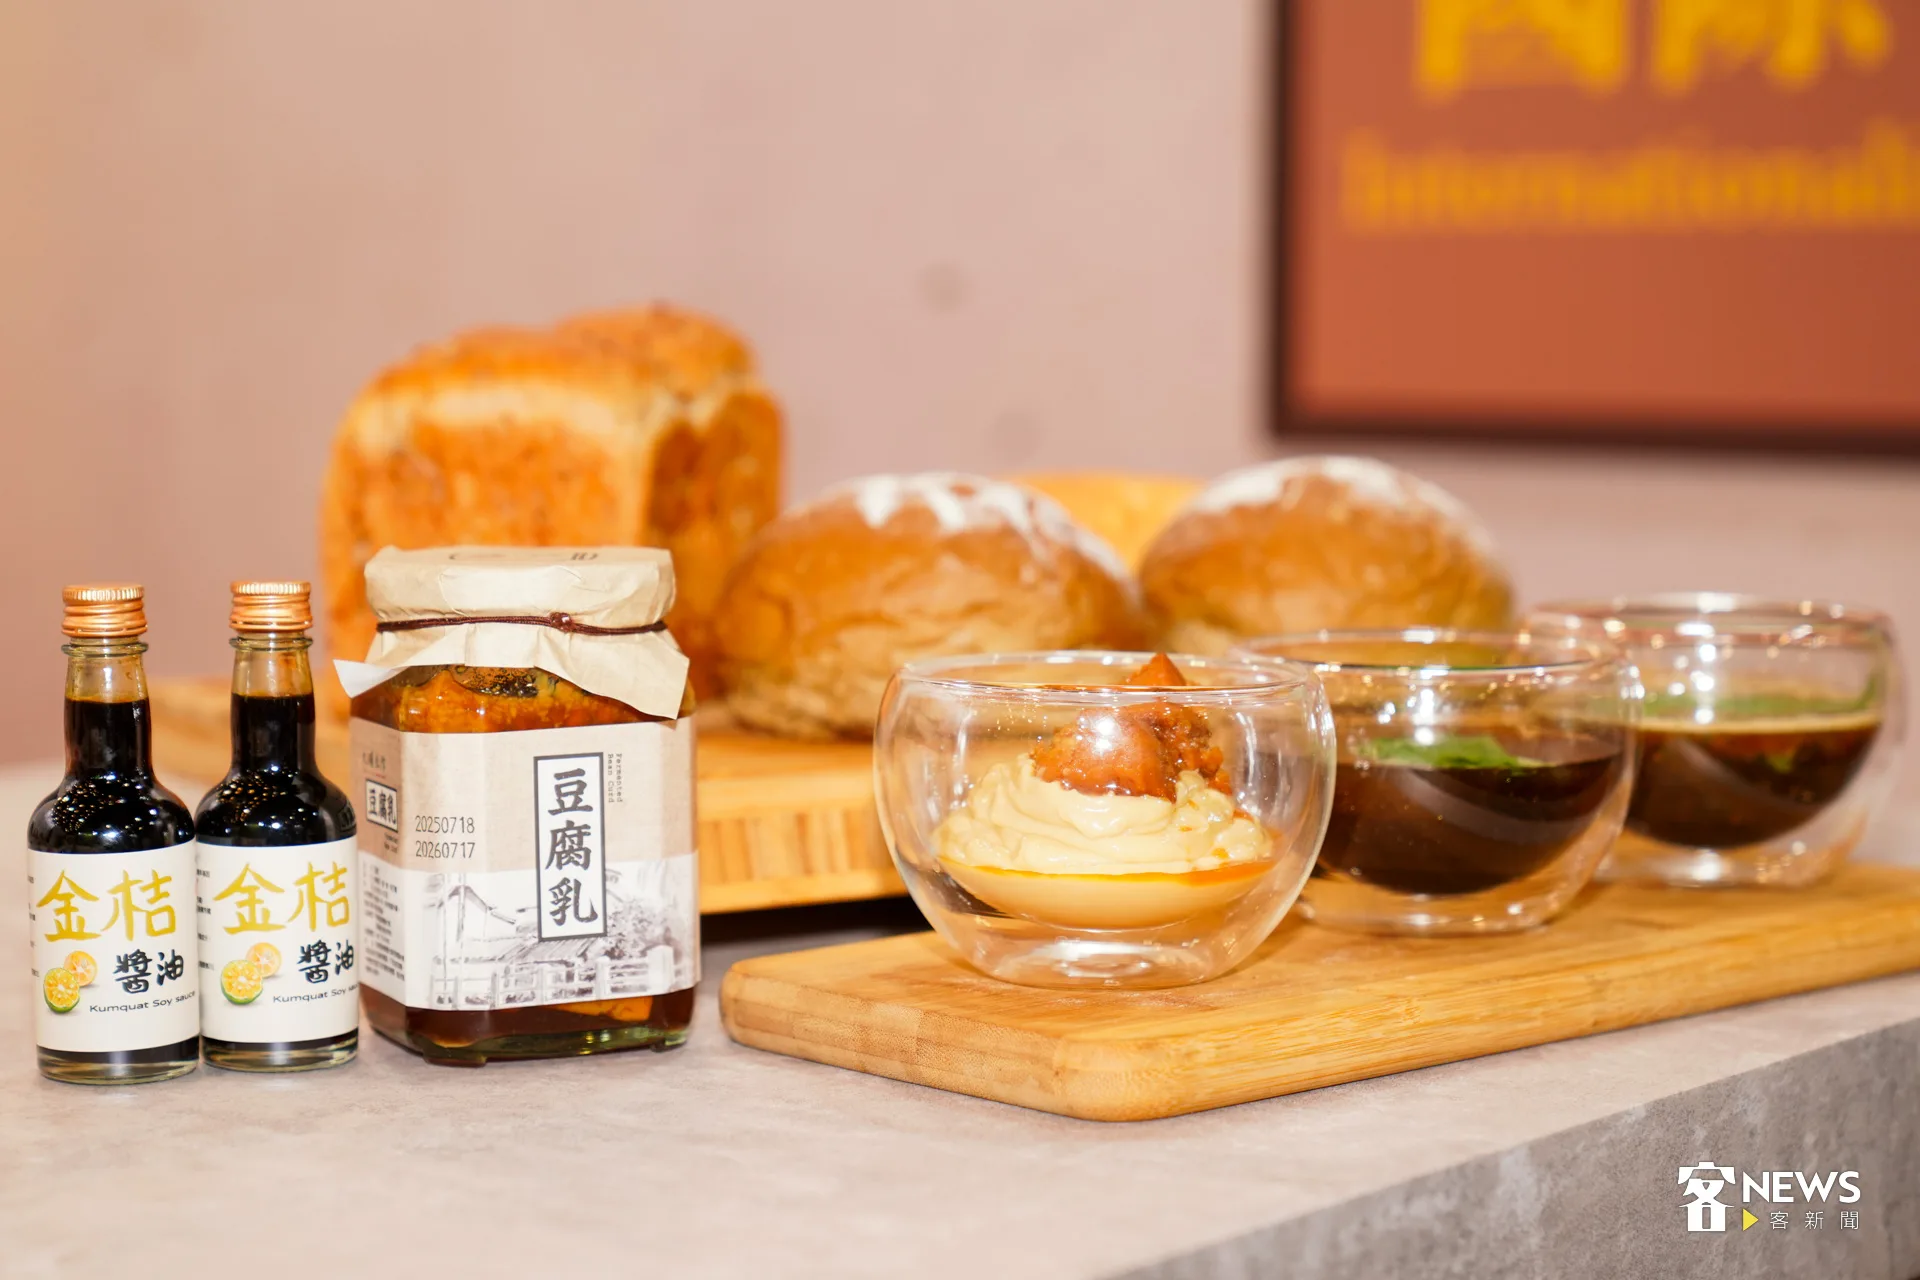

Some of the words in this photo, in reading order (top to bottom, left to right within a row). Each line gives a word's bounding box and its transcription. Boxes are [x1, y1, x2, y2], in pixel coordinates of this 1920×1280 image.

[415, 814, 476, 834] 20250718
[415, 840, 477, 860] 20260717
[545, 767, 599, 927] 豆腐乳
[36, 868, 177, 943] 金桔
[213, 860, 350, 935] 金桔
[113, 948, 184, 995] 醬油
[297, 939, 355, 984] 醬油
[89, 1001, 149, 1013] Kumquat
[152, 998, 173, 1008] Soy
[175, 990, 196, 1003] sauce
[273, 991, 329, 1003] Kumquat
[331, 988, 347, 997] Soy
